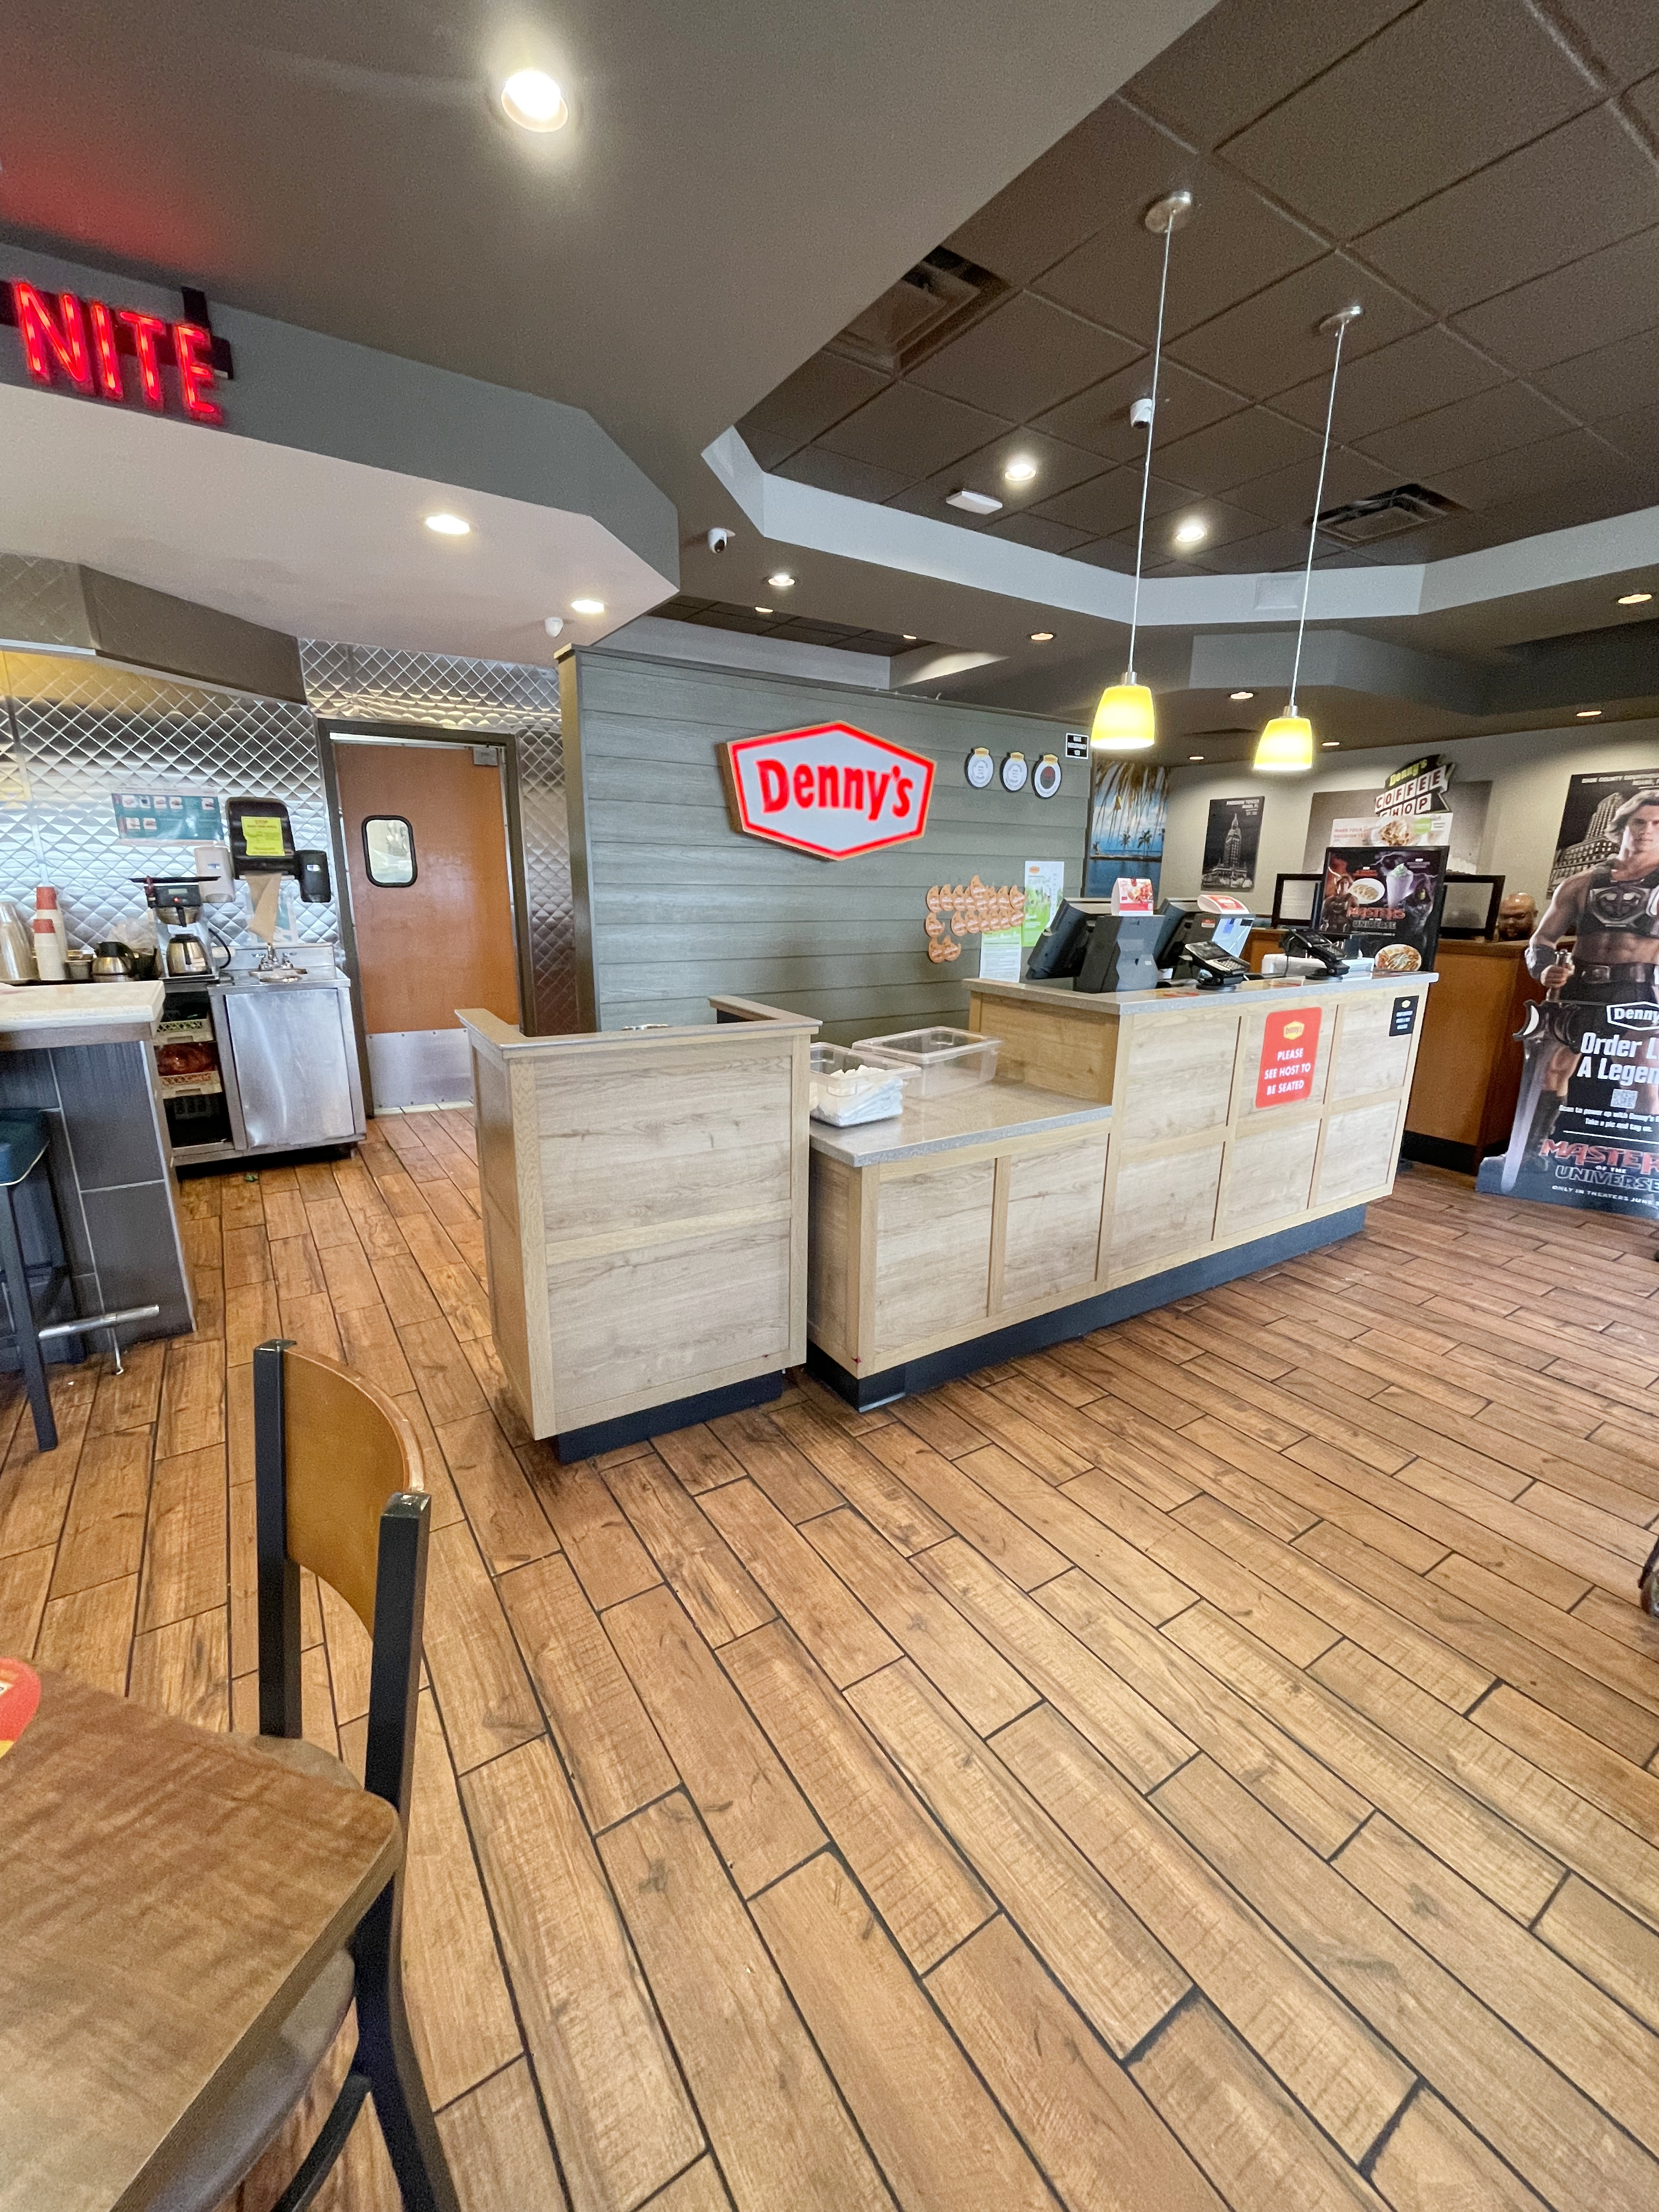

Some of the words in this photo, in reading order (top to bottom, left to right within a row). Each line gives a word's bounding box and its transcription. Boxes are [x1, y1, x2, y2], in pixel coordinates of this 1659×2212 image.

[15, 281, 218, 418] NITE
[1389, 759, 1428, 787] Denny's
[755, 759, 913, 822] Denny's
[1375, 769, 1442, 809] COFFEE
[1285, 1025, 1302, 1035] Denny's
[1277, 1048, 1304, 1062] PLEASE
[1581, 1032, 1643, 1058] Order
[1646, 1037, 1659, 1059] L
[1264, 1068, 1277, 1080] SEE
[1279, 1064, 1300, 1077] HOST
[1301, 1063, 1311, 1074] TO
[1577, 1056, 1592, 1078] A
[1598, 1058, 1659, 1086] Legen
[1266, 1085, 1277, 1096] BE
[1278, 1080, 1304, 1094] SEATED
[1555, 1165, 1659, 1193] UNIVERSE
[1587, 1190, 1629, 1201] THEATERS
[1630, 1197, 1654, 1205] JUNE
